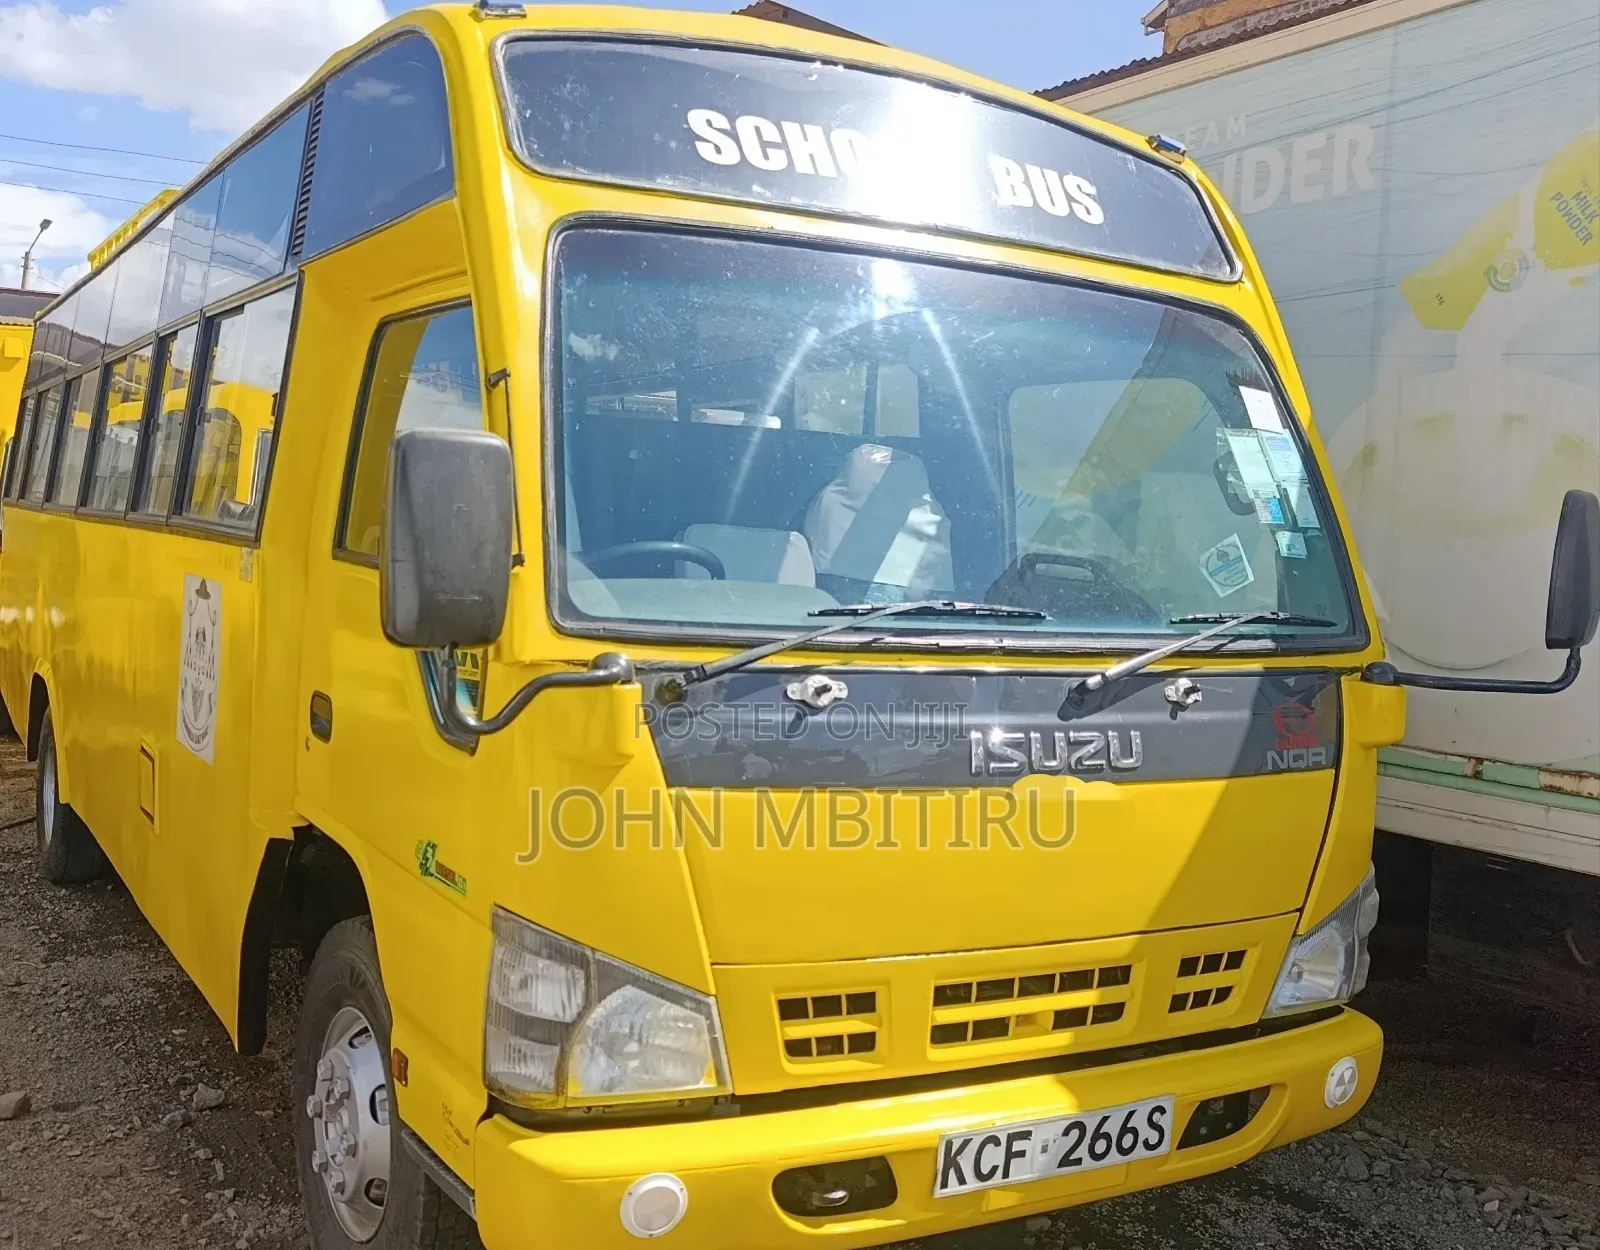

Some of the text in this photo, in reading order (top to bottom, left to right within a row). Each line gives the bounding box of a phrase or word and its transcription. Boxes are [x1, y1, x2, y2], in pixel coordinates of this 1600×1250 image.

[1183, 112, 1247, 148] EAM
[988, 154, 1105, 225] BUS
[1571, 190, 1600, 225] MILK
[1549, 191, 1593, 246] POWDER
[969, 729, 1145, 775] ISUZU
[1266, 746, 1327, 770] NQR
[939, 1104, 1167, 1191] KCF 266S
